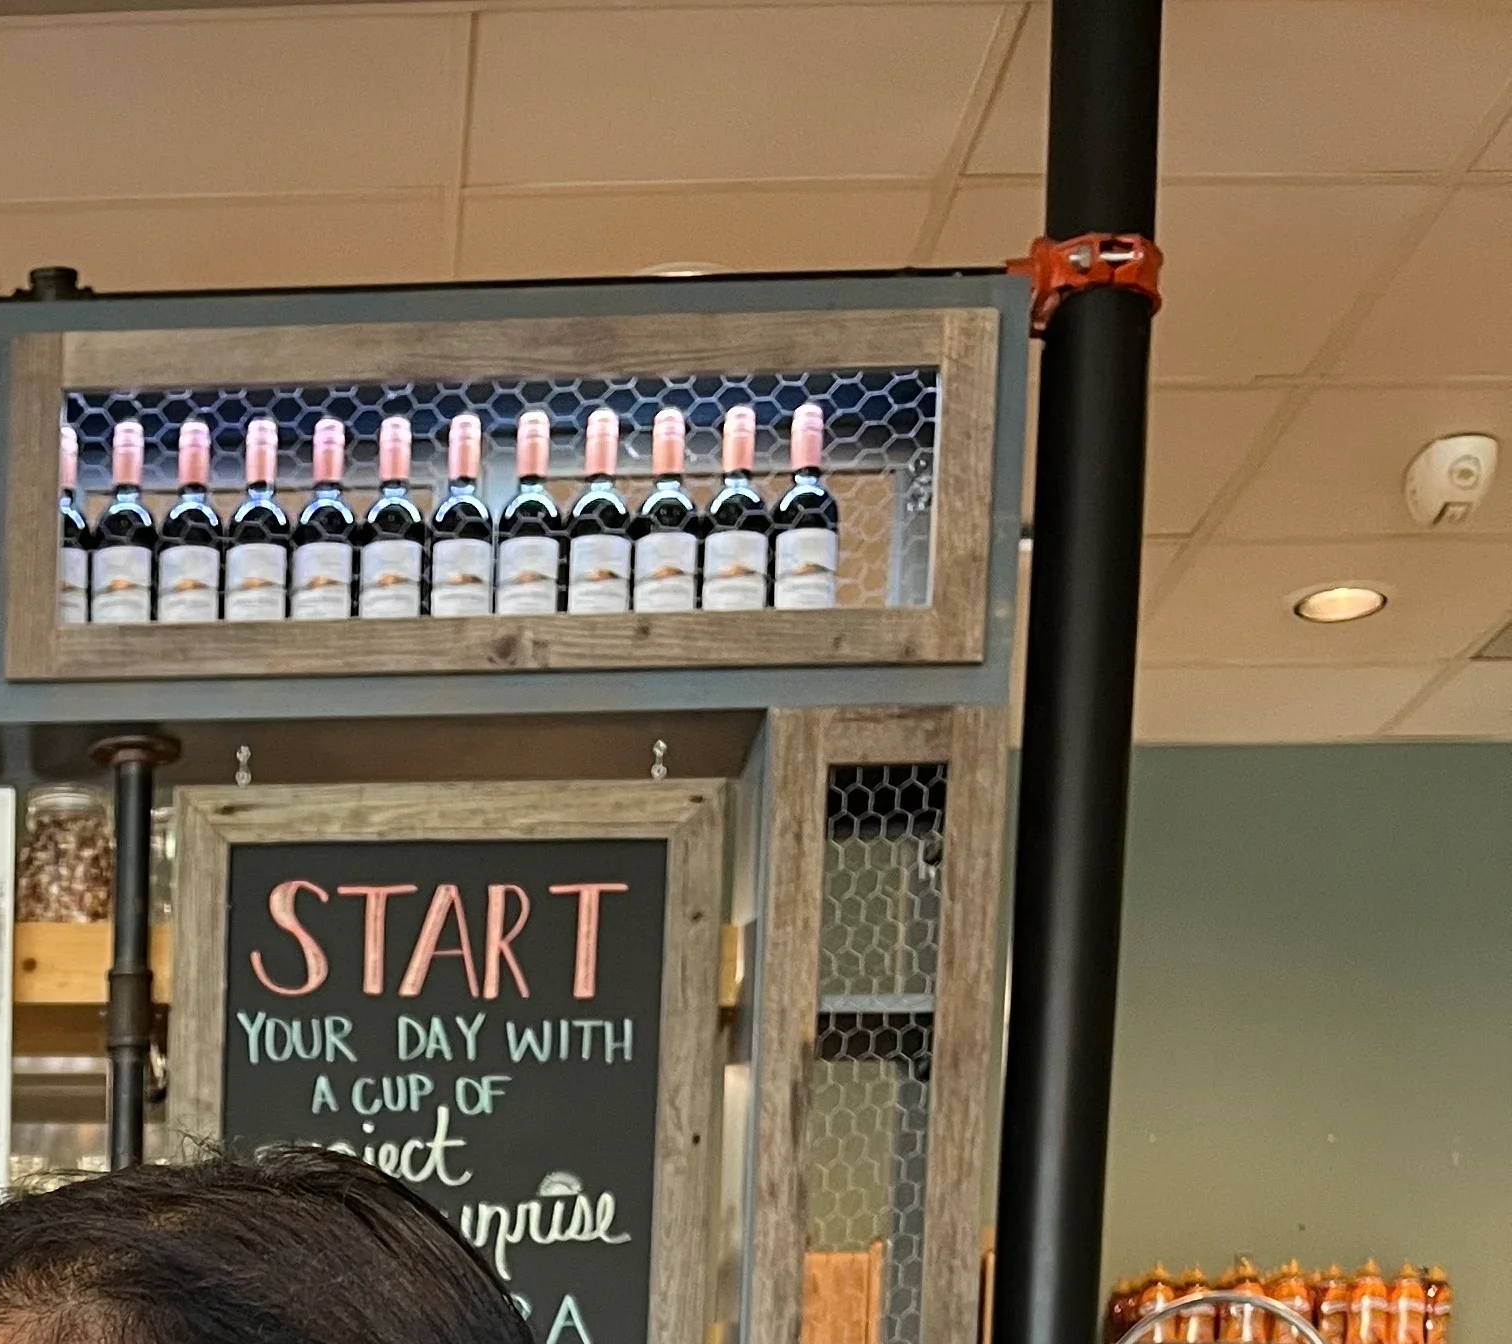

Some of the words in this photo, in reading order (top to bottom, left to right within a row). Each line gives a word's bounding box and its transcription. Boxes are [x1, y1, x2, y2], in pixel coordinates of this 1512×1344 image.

[249, 880, 629, 999] START
[236, 1010, 357, 1064] YOUR
[398, 1011, 487, 1062] DAY
[506, 1017, 633, 1064] WITH
[311, 1073, 339, 1113] A
[351, 1073, 435, 1115] CUP
[455, 1074, 512, 1114] OF
